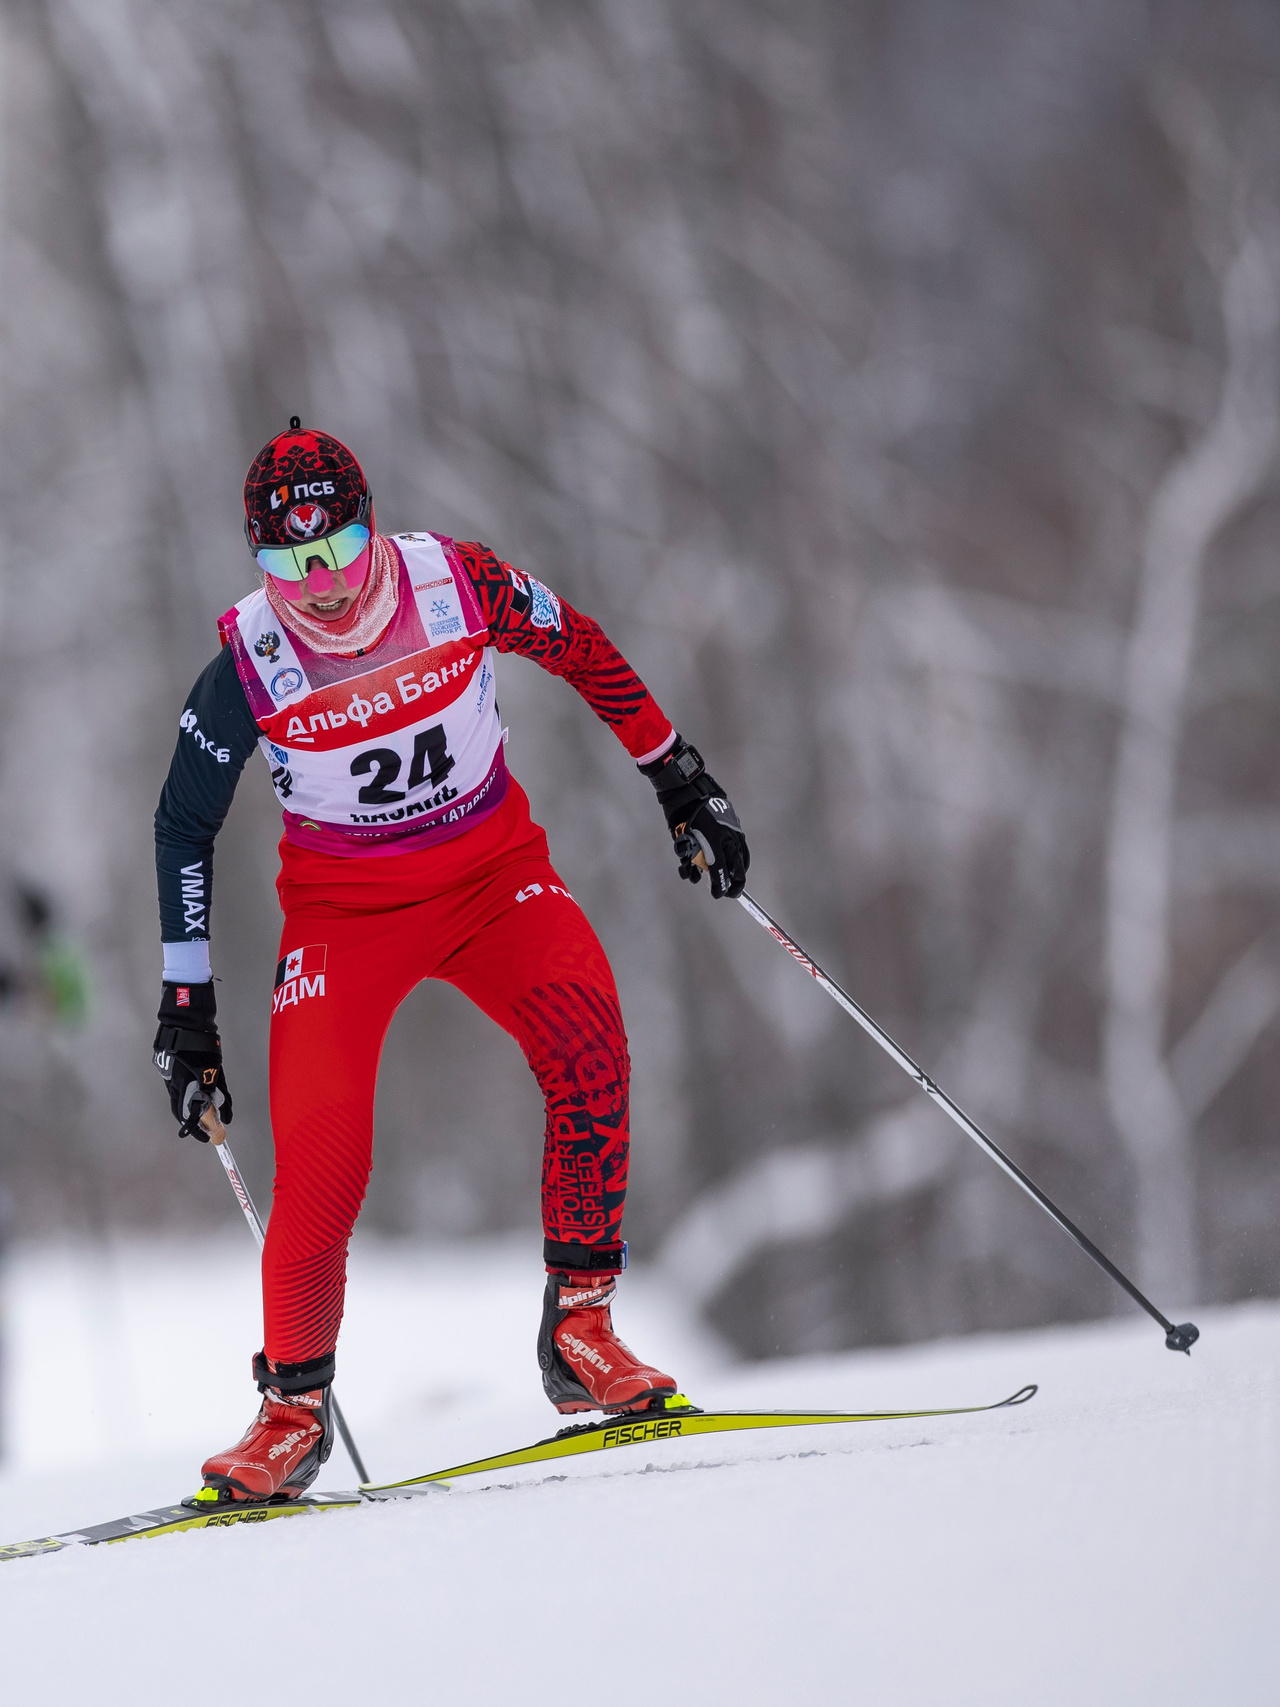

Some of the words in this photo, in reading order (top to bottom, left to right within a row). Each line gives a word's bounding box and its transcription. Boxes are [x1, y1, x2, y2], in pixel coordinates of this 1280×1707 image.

[293, 481, 336, 500] ПСБ
[286, 692, 395, 744] Альфа
[395, 652, 477, 705] Банк
[349, 723, 456, 805] 24
[180, 860, 206, 934] VMAX
[271, 974, 326, 1015] УДМ
[559, 1144, 583, 1226] POWER
[577, 1151, 606, 1226] SPEED
[560, 1332, 613, 1375] alpina
[602, 1420, 683, 1448] FISCHER
